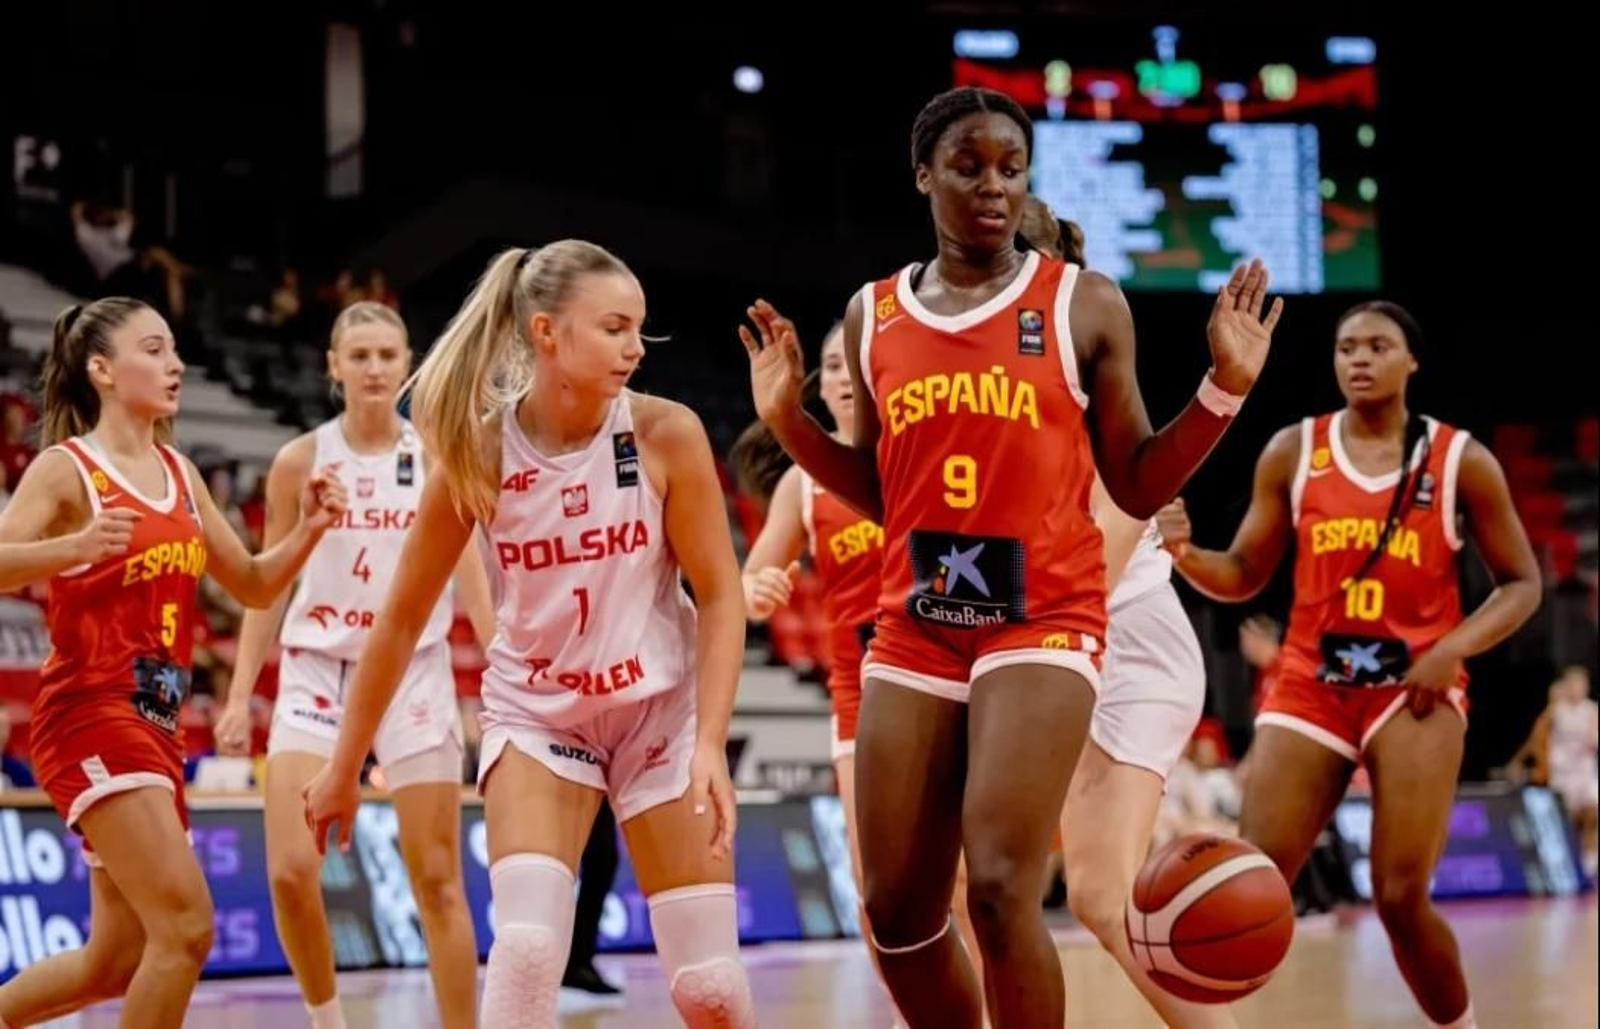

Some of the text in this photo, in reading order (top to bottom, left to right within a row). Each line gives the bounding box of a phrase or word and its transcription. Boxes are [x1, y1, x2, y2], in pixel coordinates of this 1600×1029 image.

[887, 365, 1040, 436] ESPAÑA
[944, 455, 977, 509] 9
[352, 546, 371, 583] 4
[496, 519, 648, 572] POLSKA
[344, 610, 375, 628] OR
[572, 587, 590, 637] 1
[916, 597, 1009, 628] CaixaBank
[1340, 577, 1385, 621] 10
[161, 603, 178, 648] 5
[556, 653, 645, 696] ORLEN
[549, 743, 600, 766] SUZU
